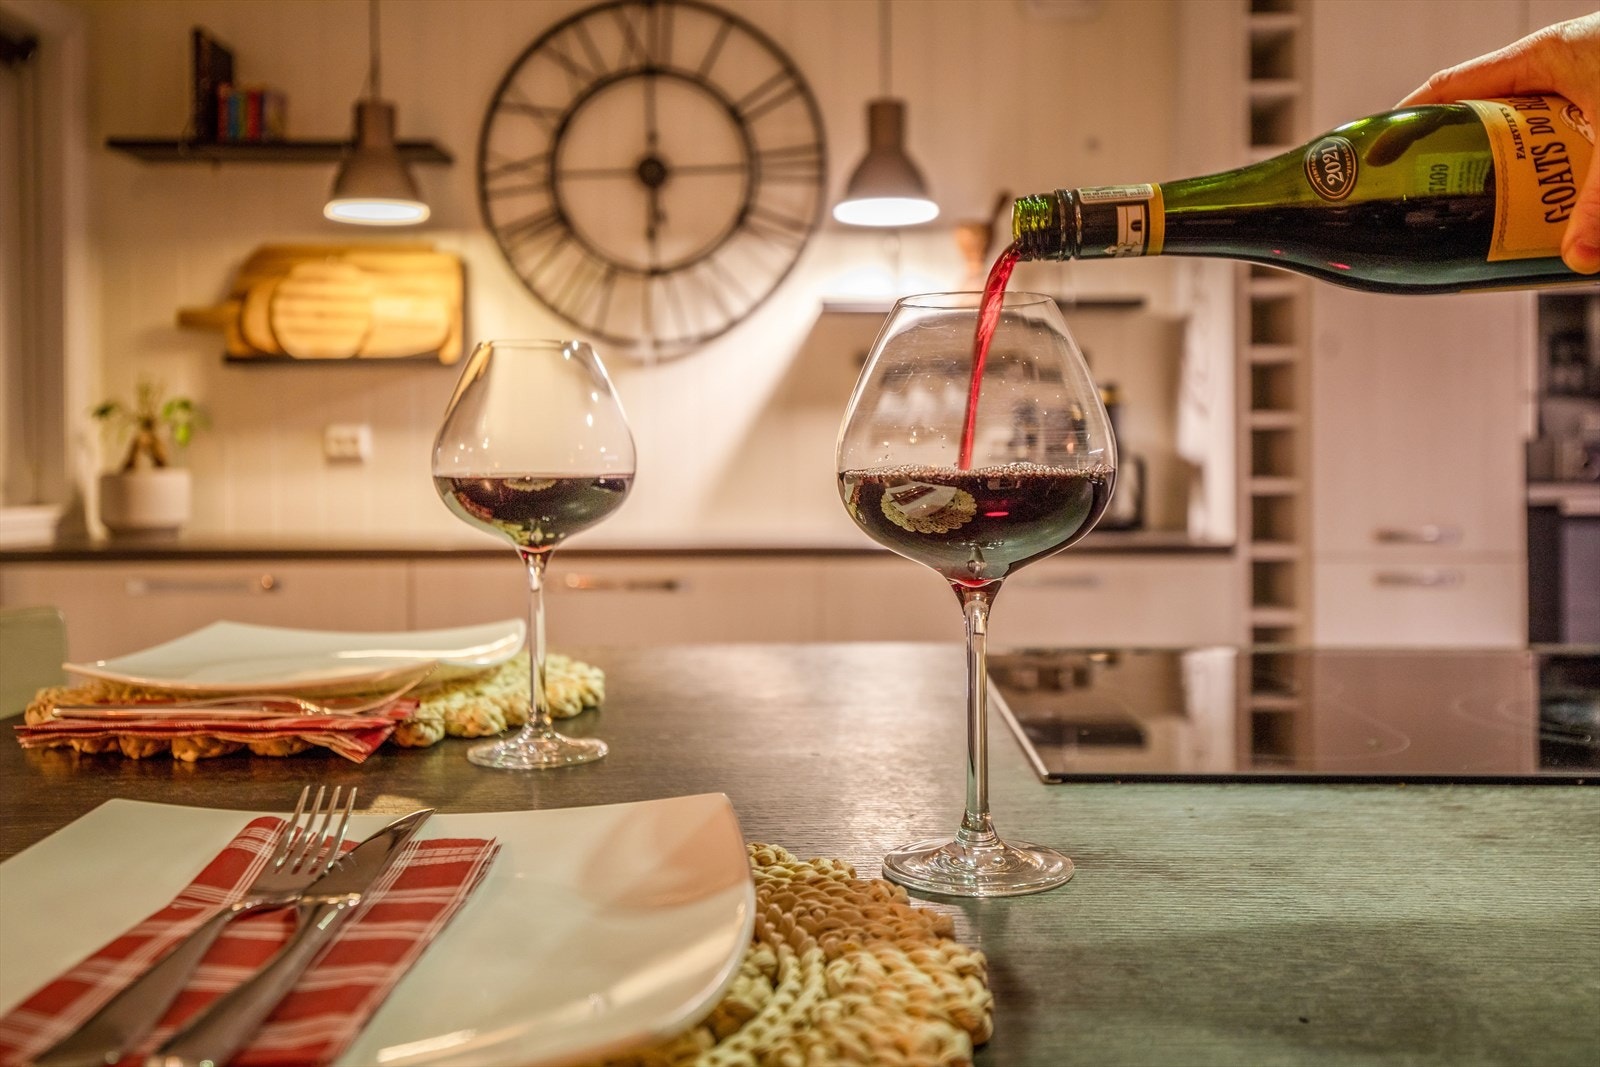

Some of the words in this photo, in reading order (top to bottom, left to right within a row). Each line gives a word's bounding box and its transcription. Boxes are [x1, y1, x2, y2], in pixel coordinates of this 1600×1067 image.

[1525, 116, 1556, 135] DO
[1321, 144, 1344, 186] 2021
[1530, 141, 1577, 224] GOATS
